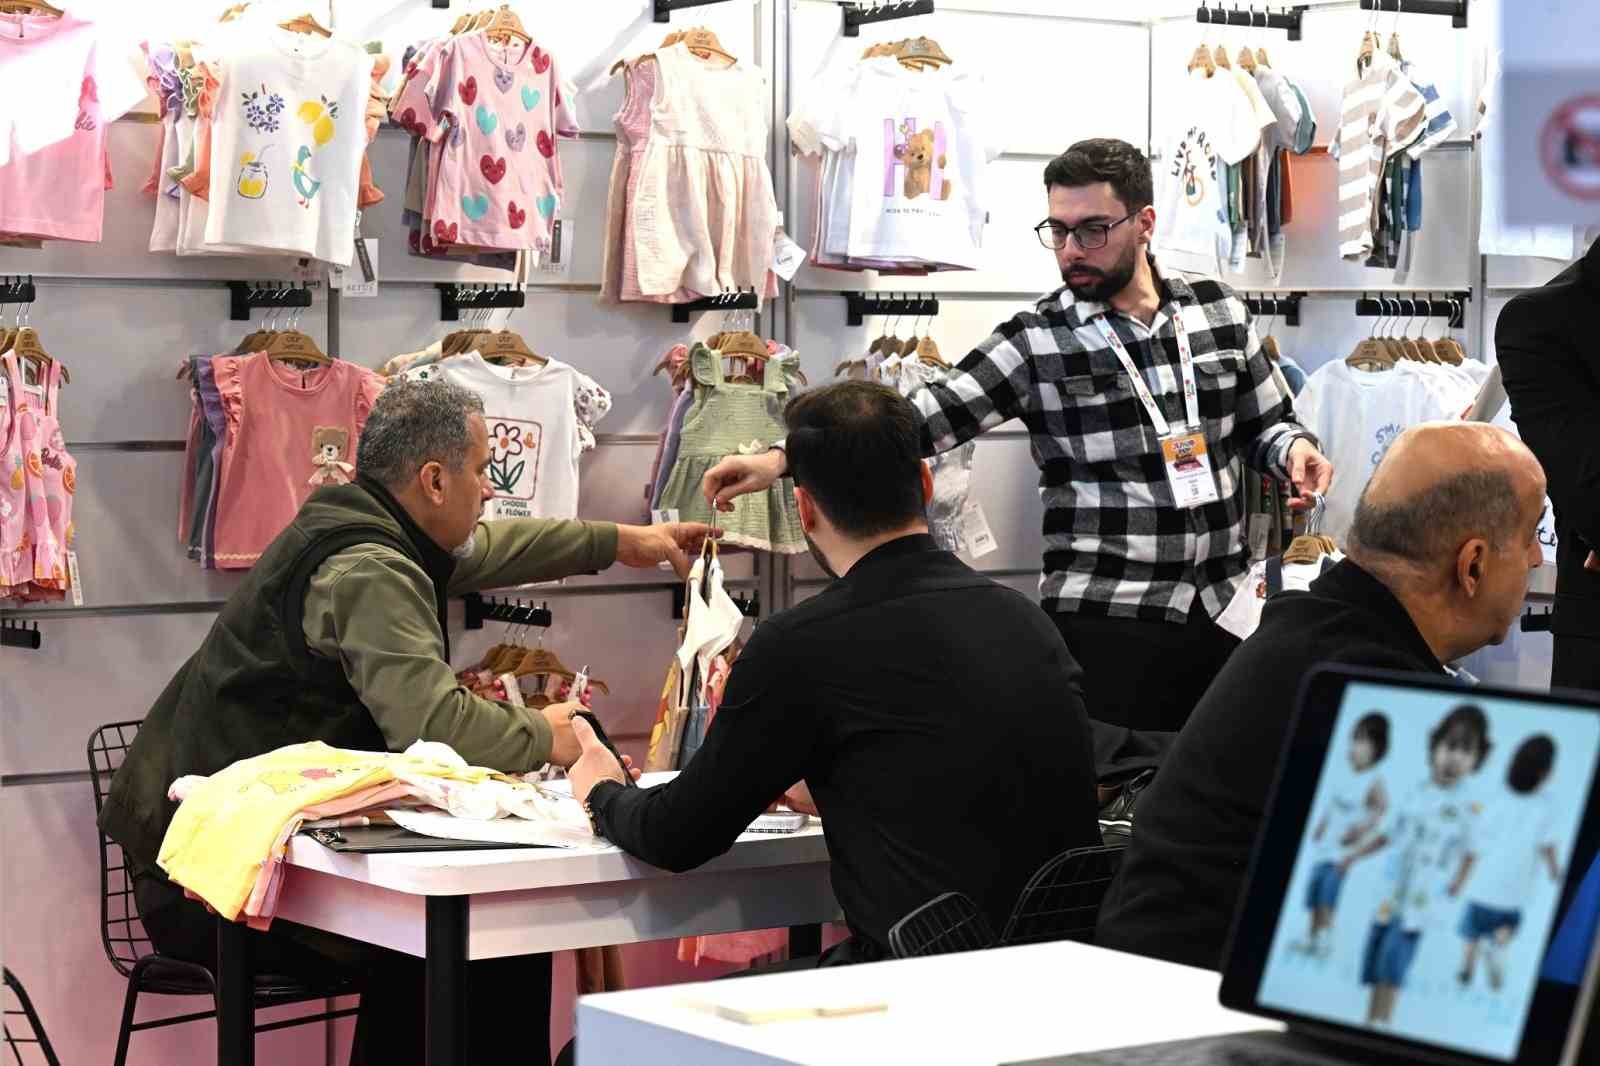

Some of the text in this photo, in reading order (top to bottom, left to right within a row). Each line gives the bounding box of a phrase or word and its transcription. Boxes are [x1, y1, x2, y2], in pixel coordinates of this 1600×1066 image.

[502, 500, 528, 509] CHOOSE
[496, 507, 532, 518] A FLOWER
